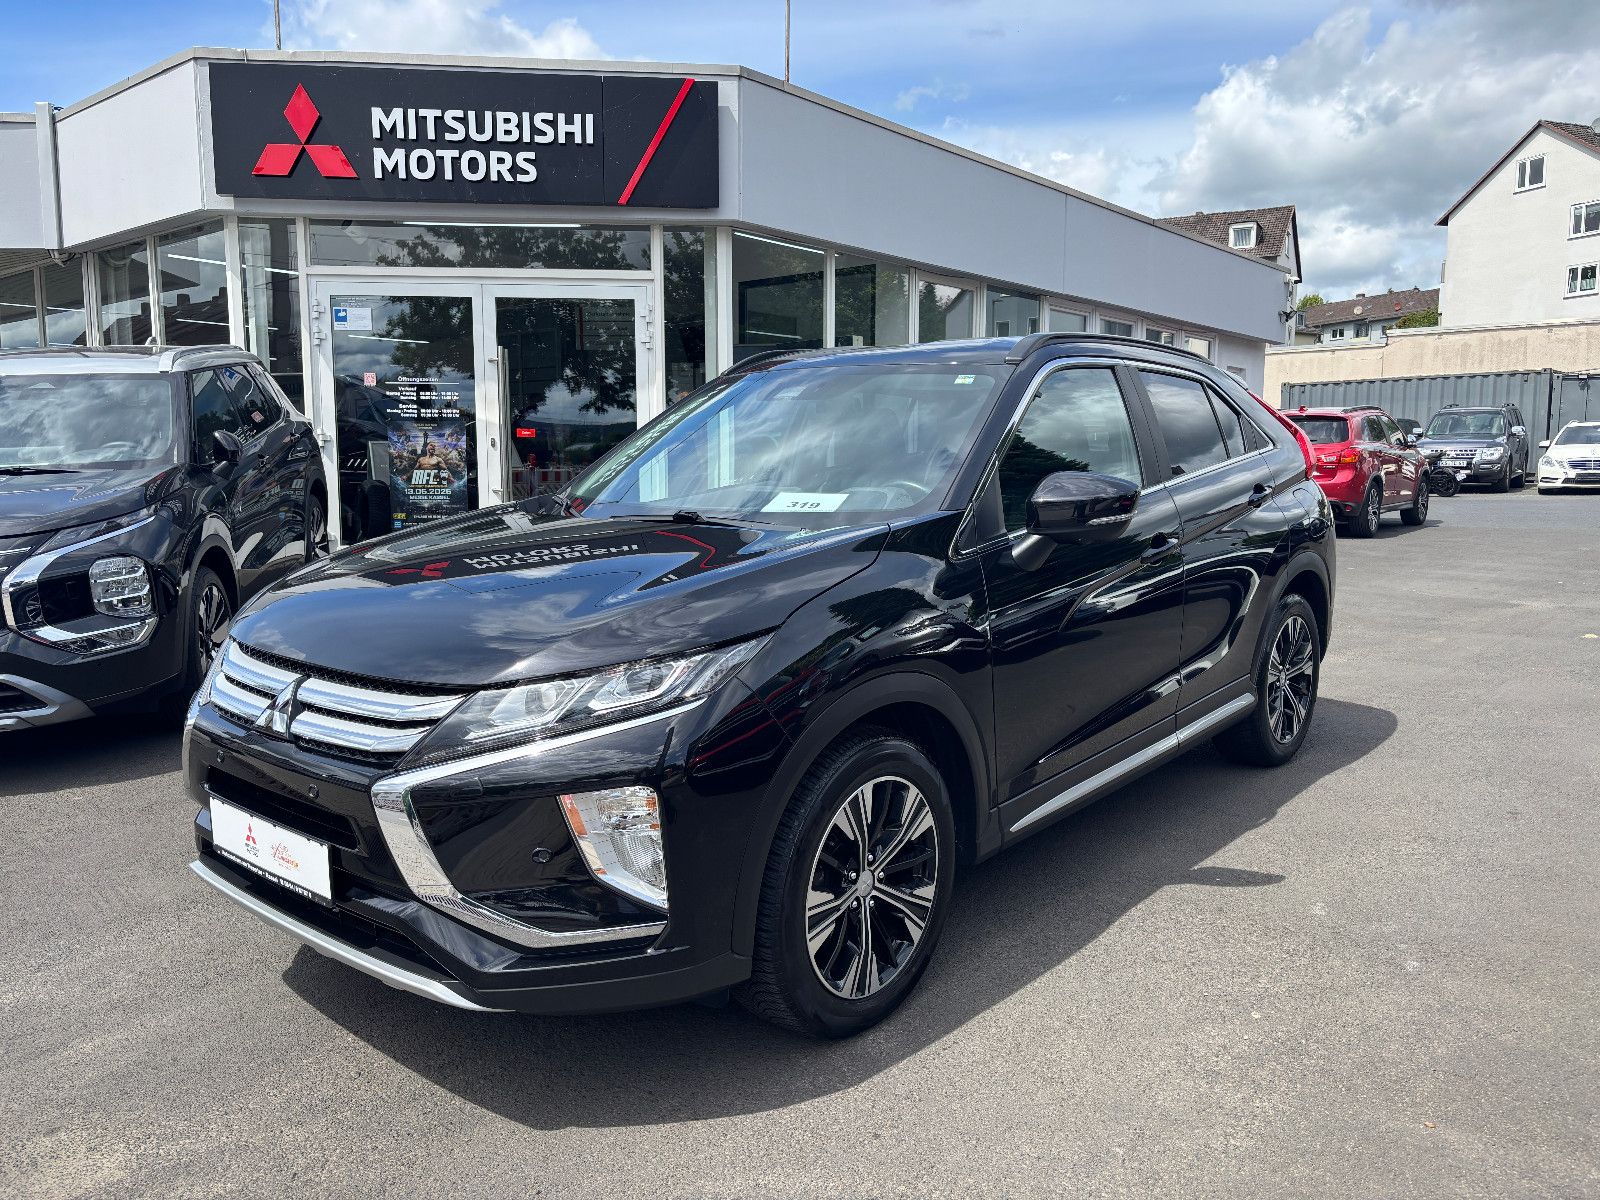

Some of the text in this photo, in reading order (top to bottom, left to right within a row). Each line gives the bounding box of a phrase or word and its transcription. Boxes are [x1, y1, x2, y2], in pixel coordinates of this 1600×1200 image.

[371, 107, 594, 145] MITSUBISHI
[373, 147, 538, 183] MOTORS
[411, 470, 438, 484] MFC
[786, 501, 821, 509] 319
